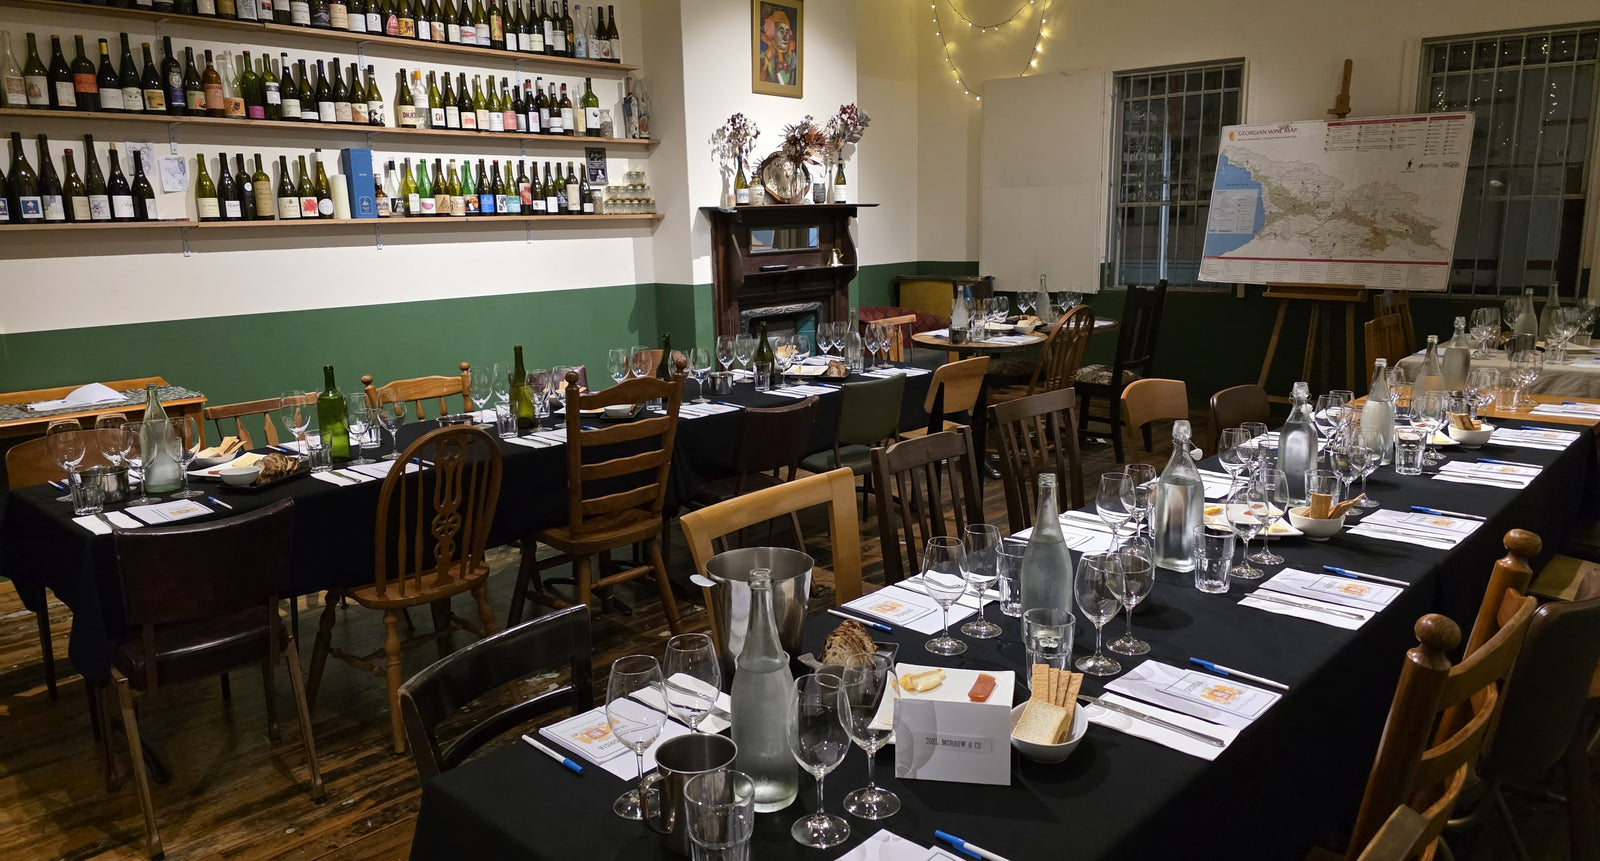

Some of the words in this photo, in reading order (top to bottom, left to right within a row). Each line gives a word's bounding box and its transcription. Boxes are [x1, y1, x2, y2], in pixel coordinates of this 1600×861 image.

[1268, 127, 1282, 135] WINE
[925, 737, 939, 746] JOEL
[941, 739, 966, 748] MORROW
